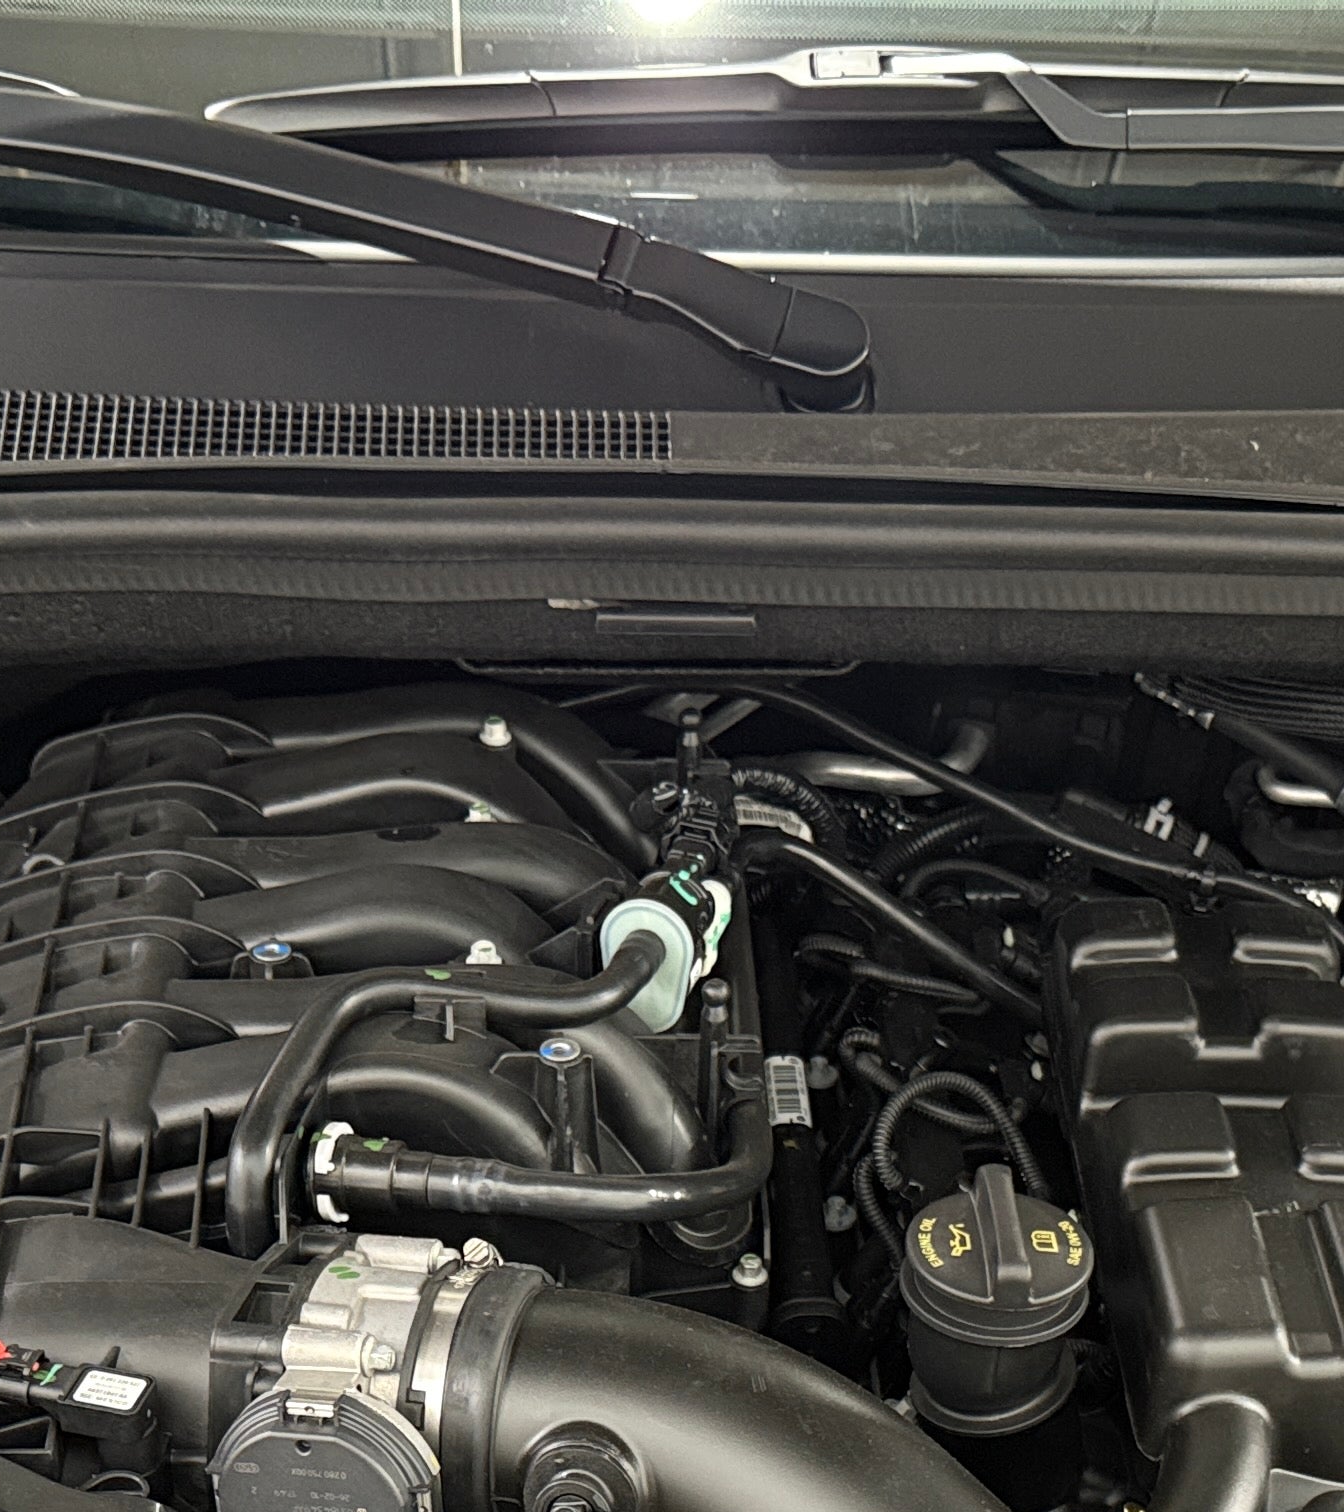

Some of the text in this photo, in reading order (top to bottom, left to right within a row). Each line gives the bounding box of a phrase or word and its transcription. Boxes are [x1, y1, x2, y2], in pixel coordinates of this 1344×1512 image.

[918, 1216, 945, 1269] ENGINE OIL
[1066, 1247, 1083, 1267] SAE
